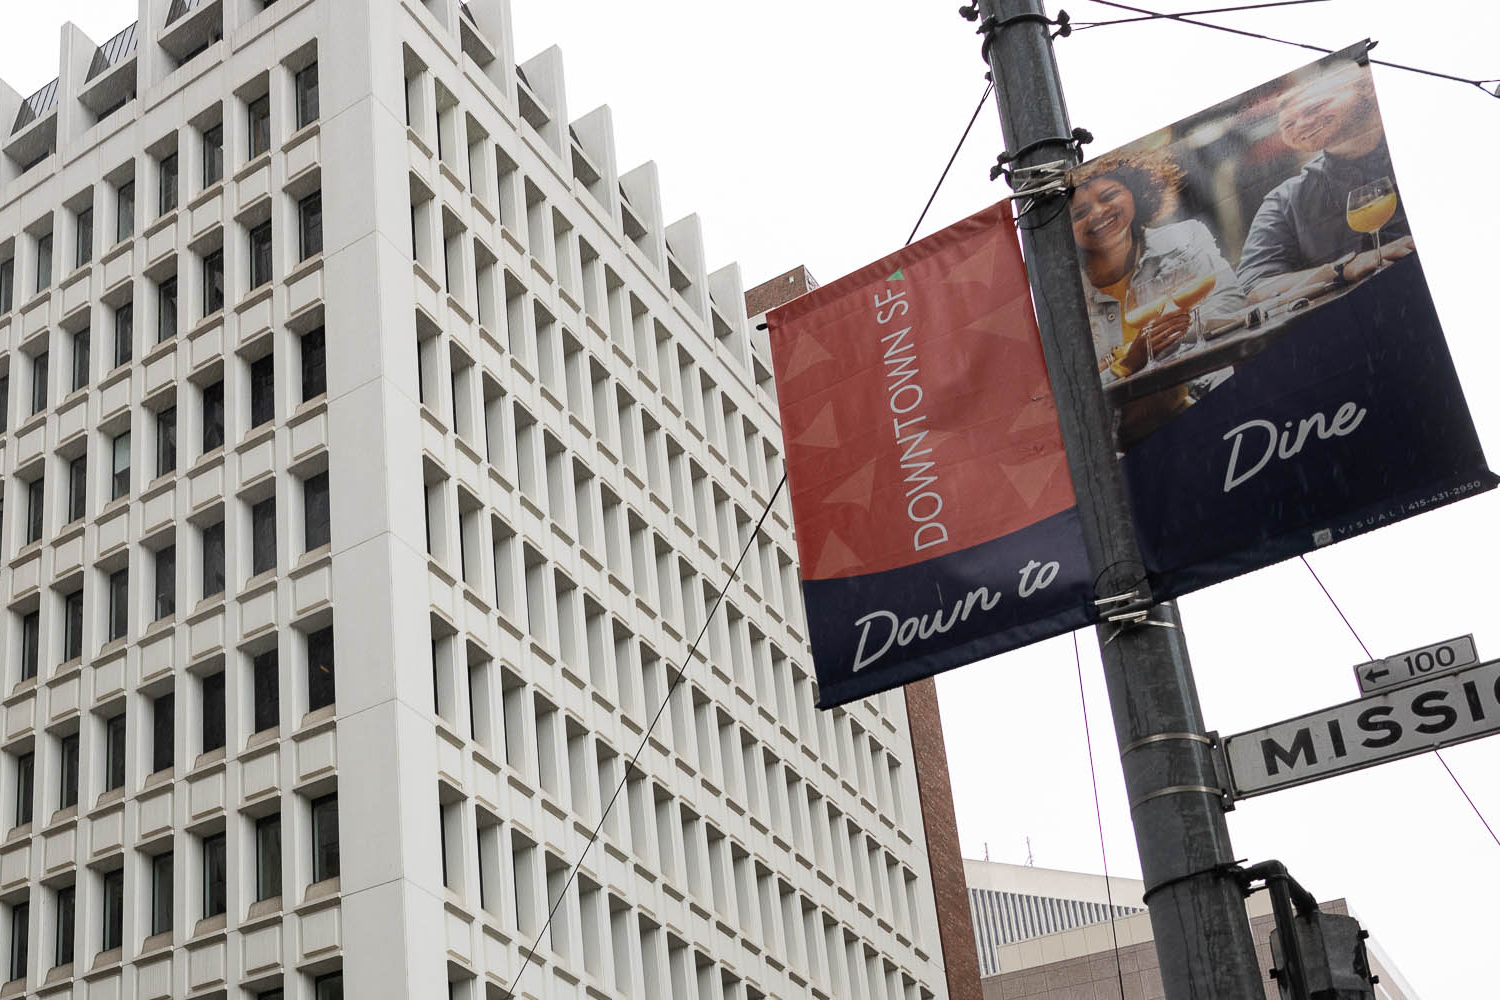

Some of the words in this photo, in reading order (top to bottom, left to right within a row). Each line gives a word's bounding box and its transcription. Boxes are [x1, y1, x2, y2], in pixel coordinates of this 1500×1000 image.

[873, 286, 912, 328] SF
[883, 336, 948, 550] DOWNTOWN
[1222, 400, 1366, 493] Dine
[1338, 511, 1396, 534] VISUAL
[1408, 480, 1481, 510] 415-431-2950
[852, 590, 1000, 672] Down
[1019, 559, 1060, 597] to
[1404, 646, 1456, 676] 100
[1260, 668, 1500, 777] MISSI
